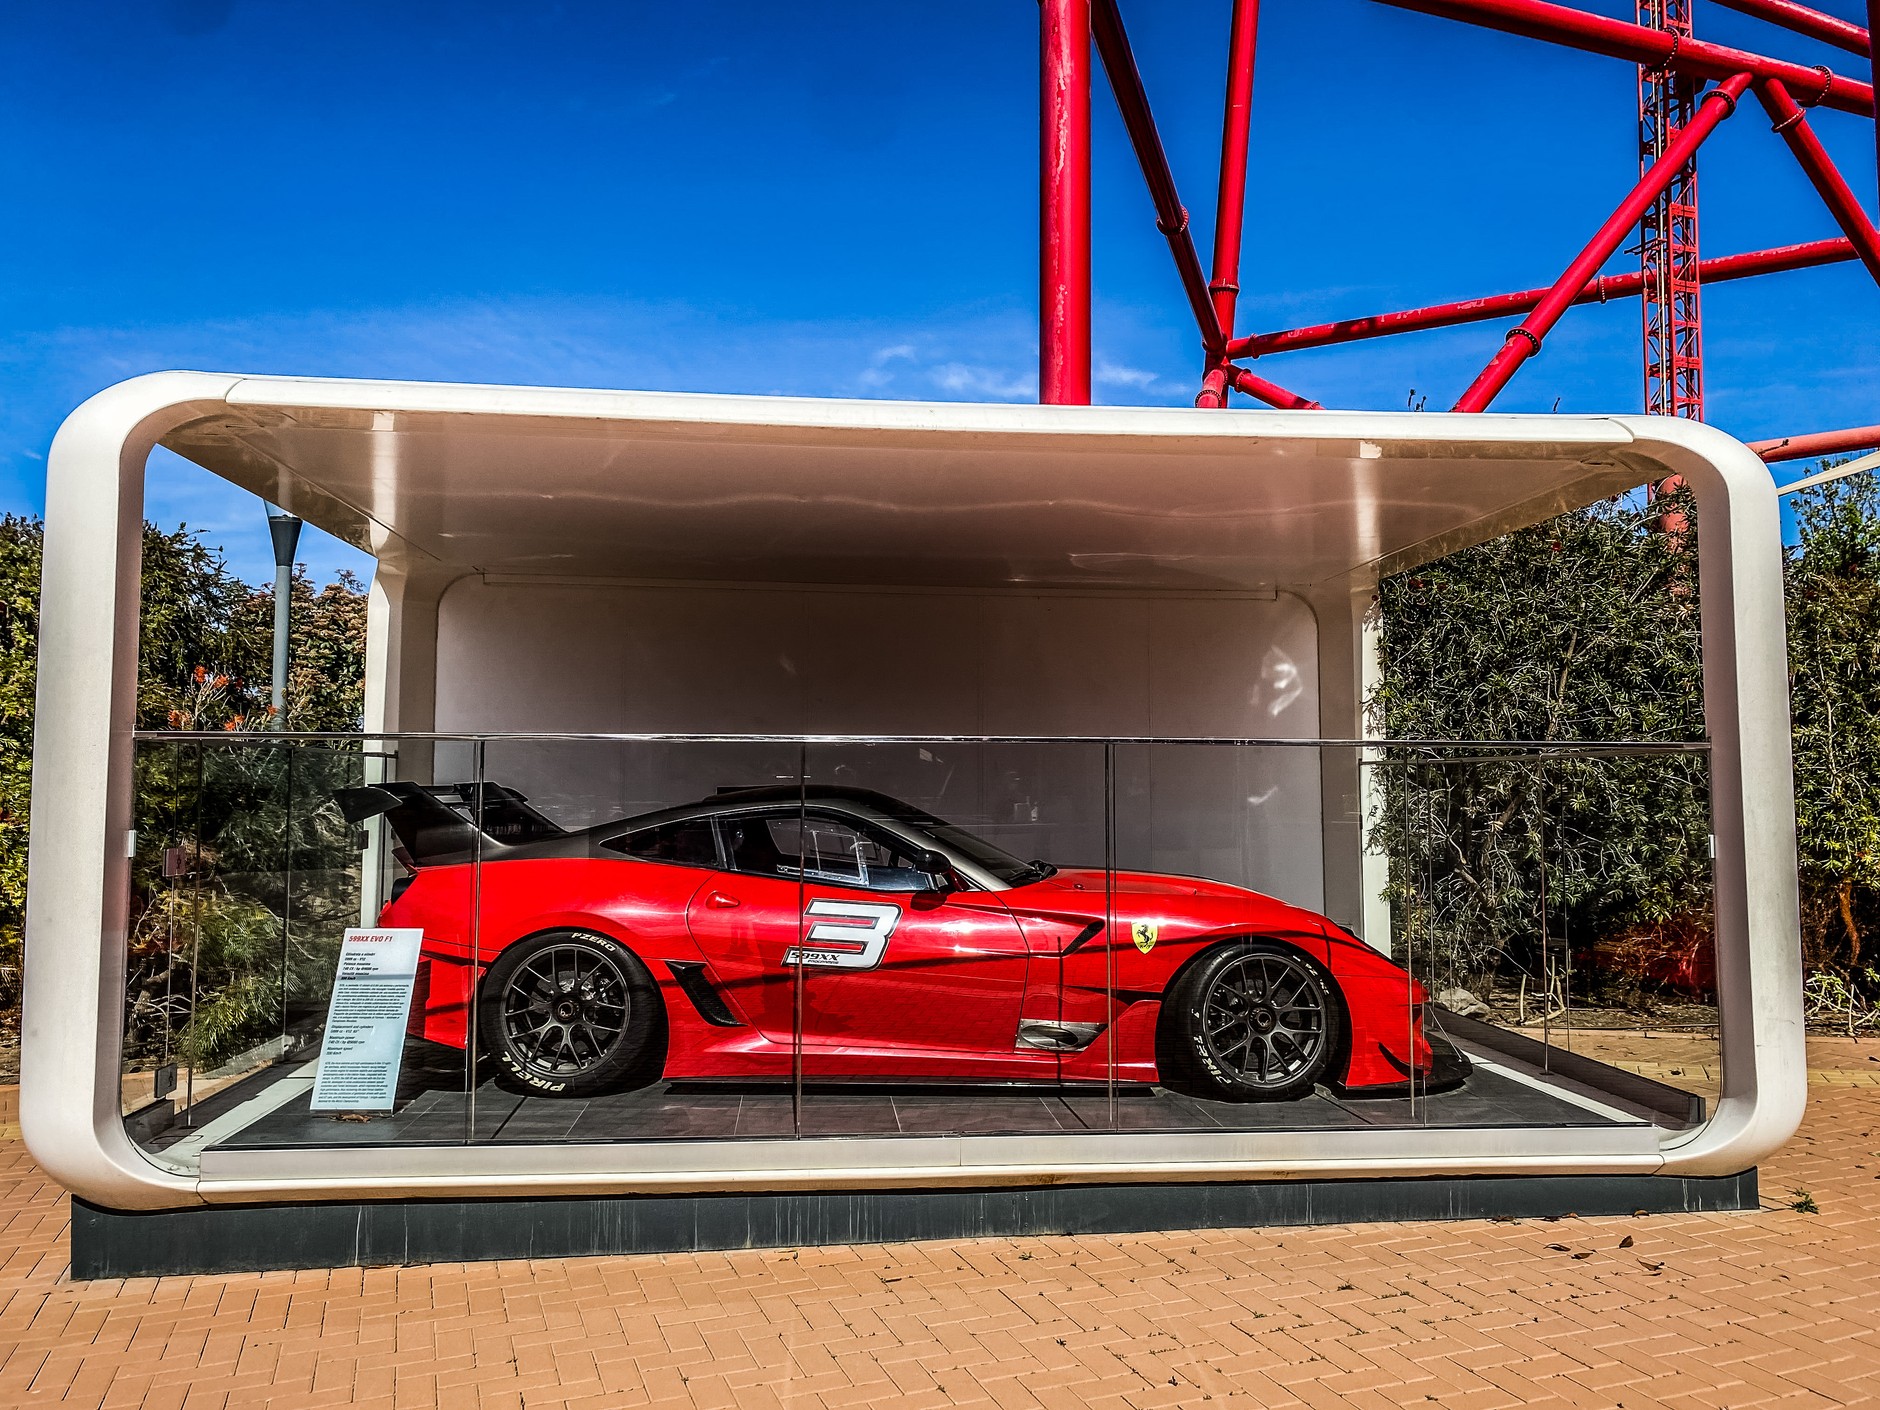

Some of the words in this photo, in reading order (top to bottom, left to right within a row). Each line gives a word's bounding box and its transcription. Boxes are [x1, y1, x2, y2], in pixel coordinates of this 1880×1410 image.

[570, 932, 617, 952] PZERO
[780, 897, 903, 973] 3
[790, 952, 840, 961] 599XX
